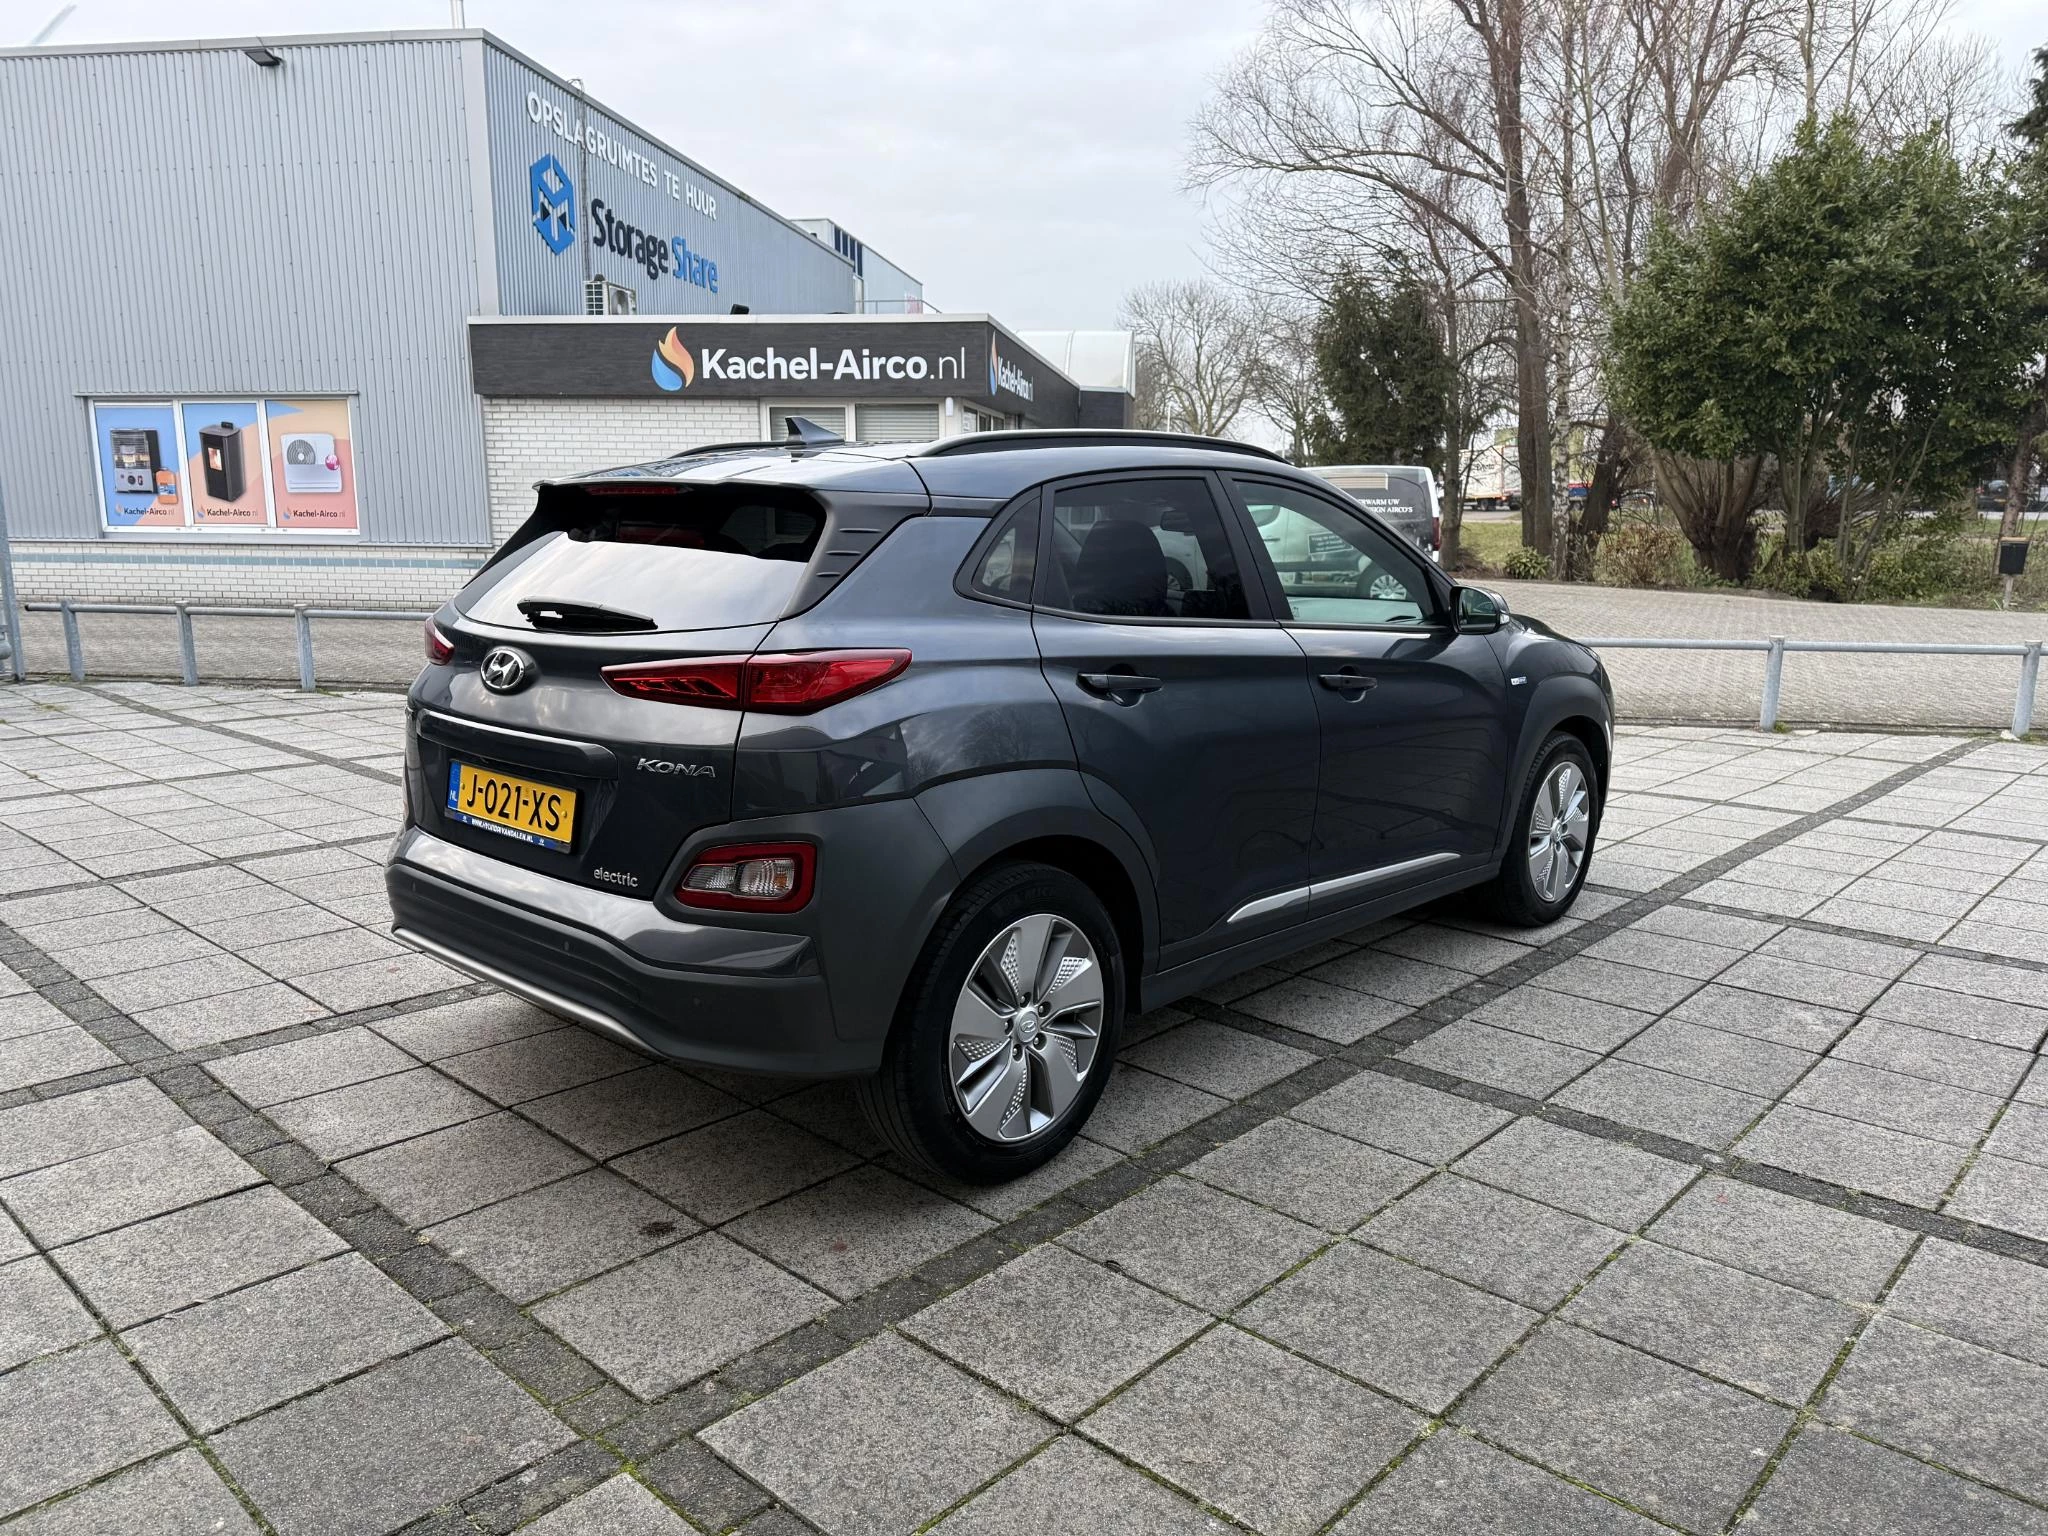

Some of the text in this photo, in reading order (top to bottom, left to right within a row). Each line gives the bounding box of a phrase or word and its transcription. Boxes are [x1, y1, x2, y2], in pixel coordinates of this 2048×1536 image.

[526, 90, 717, 221] OPSLAGRUIMTES TE HUUR
[591, 198, 719, 293] Storage Share
[702, 346, 966, 381] Kachel-Airco.nl
[1387, 498, 1400, 506] UW
[636, 757, 717, 779] KONA
[449, 789, 459, 802] NL
[466, 774, 561, 832] J-021-XS
[593, 866, 639, 888] electric
